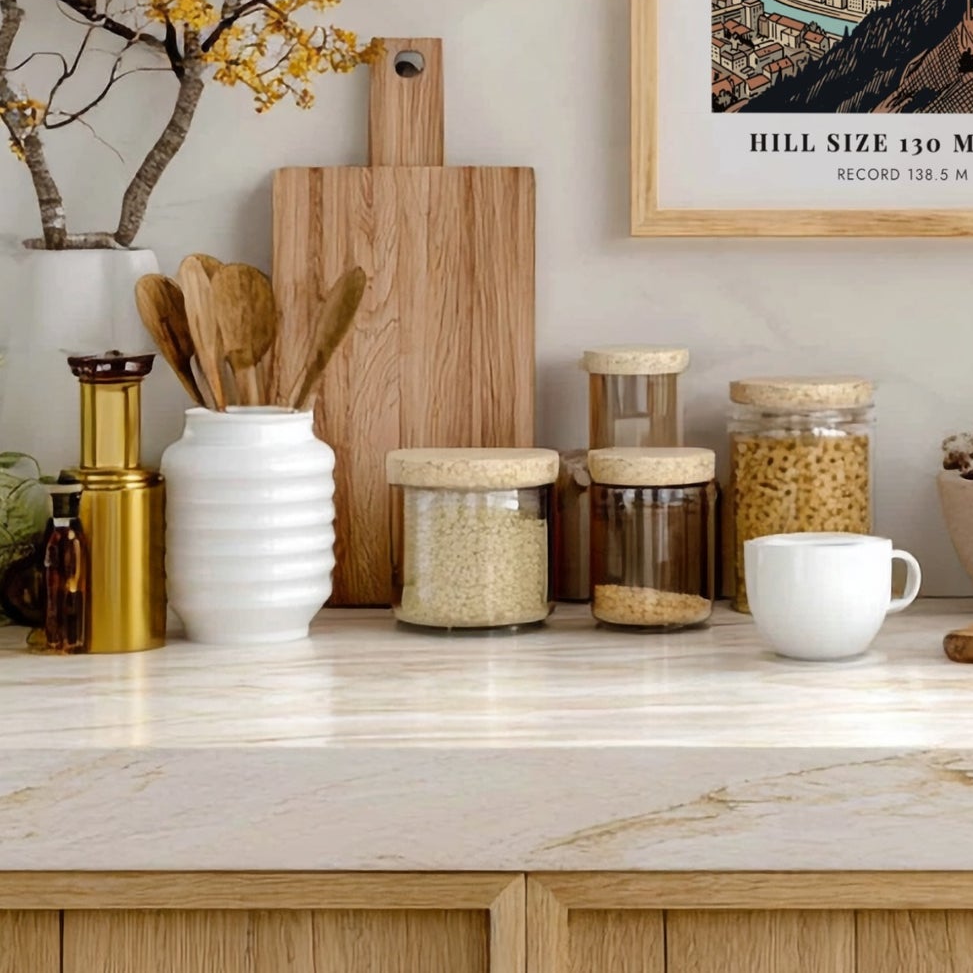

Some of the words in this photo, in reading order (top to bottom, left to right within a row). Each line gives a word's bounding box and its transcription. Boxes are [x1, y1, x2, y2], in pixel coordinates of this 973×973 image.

[750, 133, 816, 153] HILL
[827, 133, 888, 153] SIZE
[899, 138, 941, 156] 130
[953, 133, 973, 153] M
[837, 167, 900, 181] RECORD
[908, 168, 949, 181] 138.5
[955, 168, 968, 181] M
